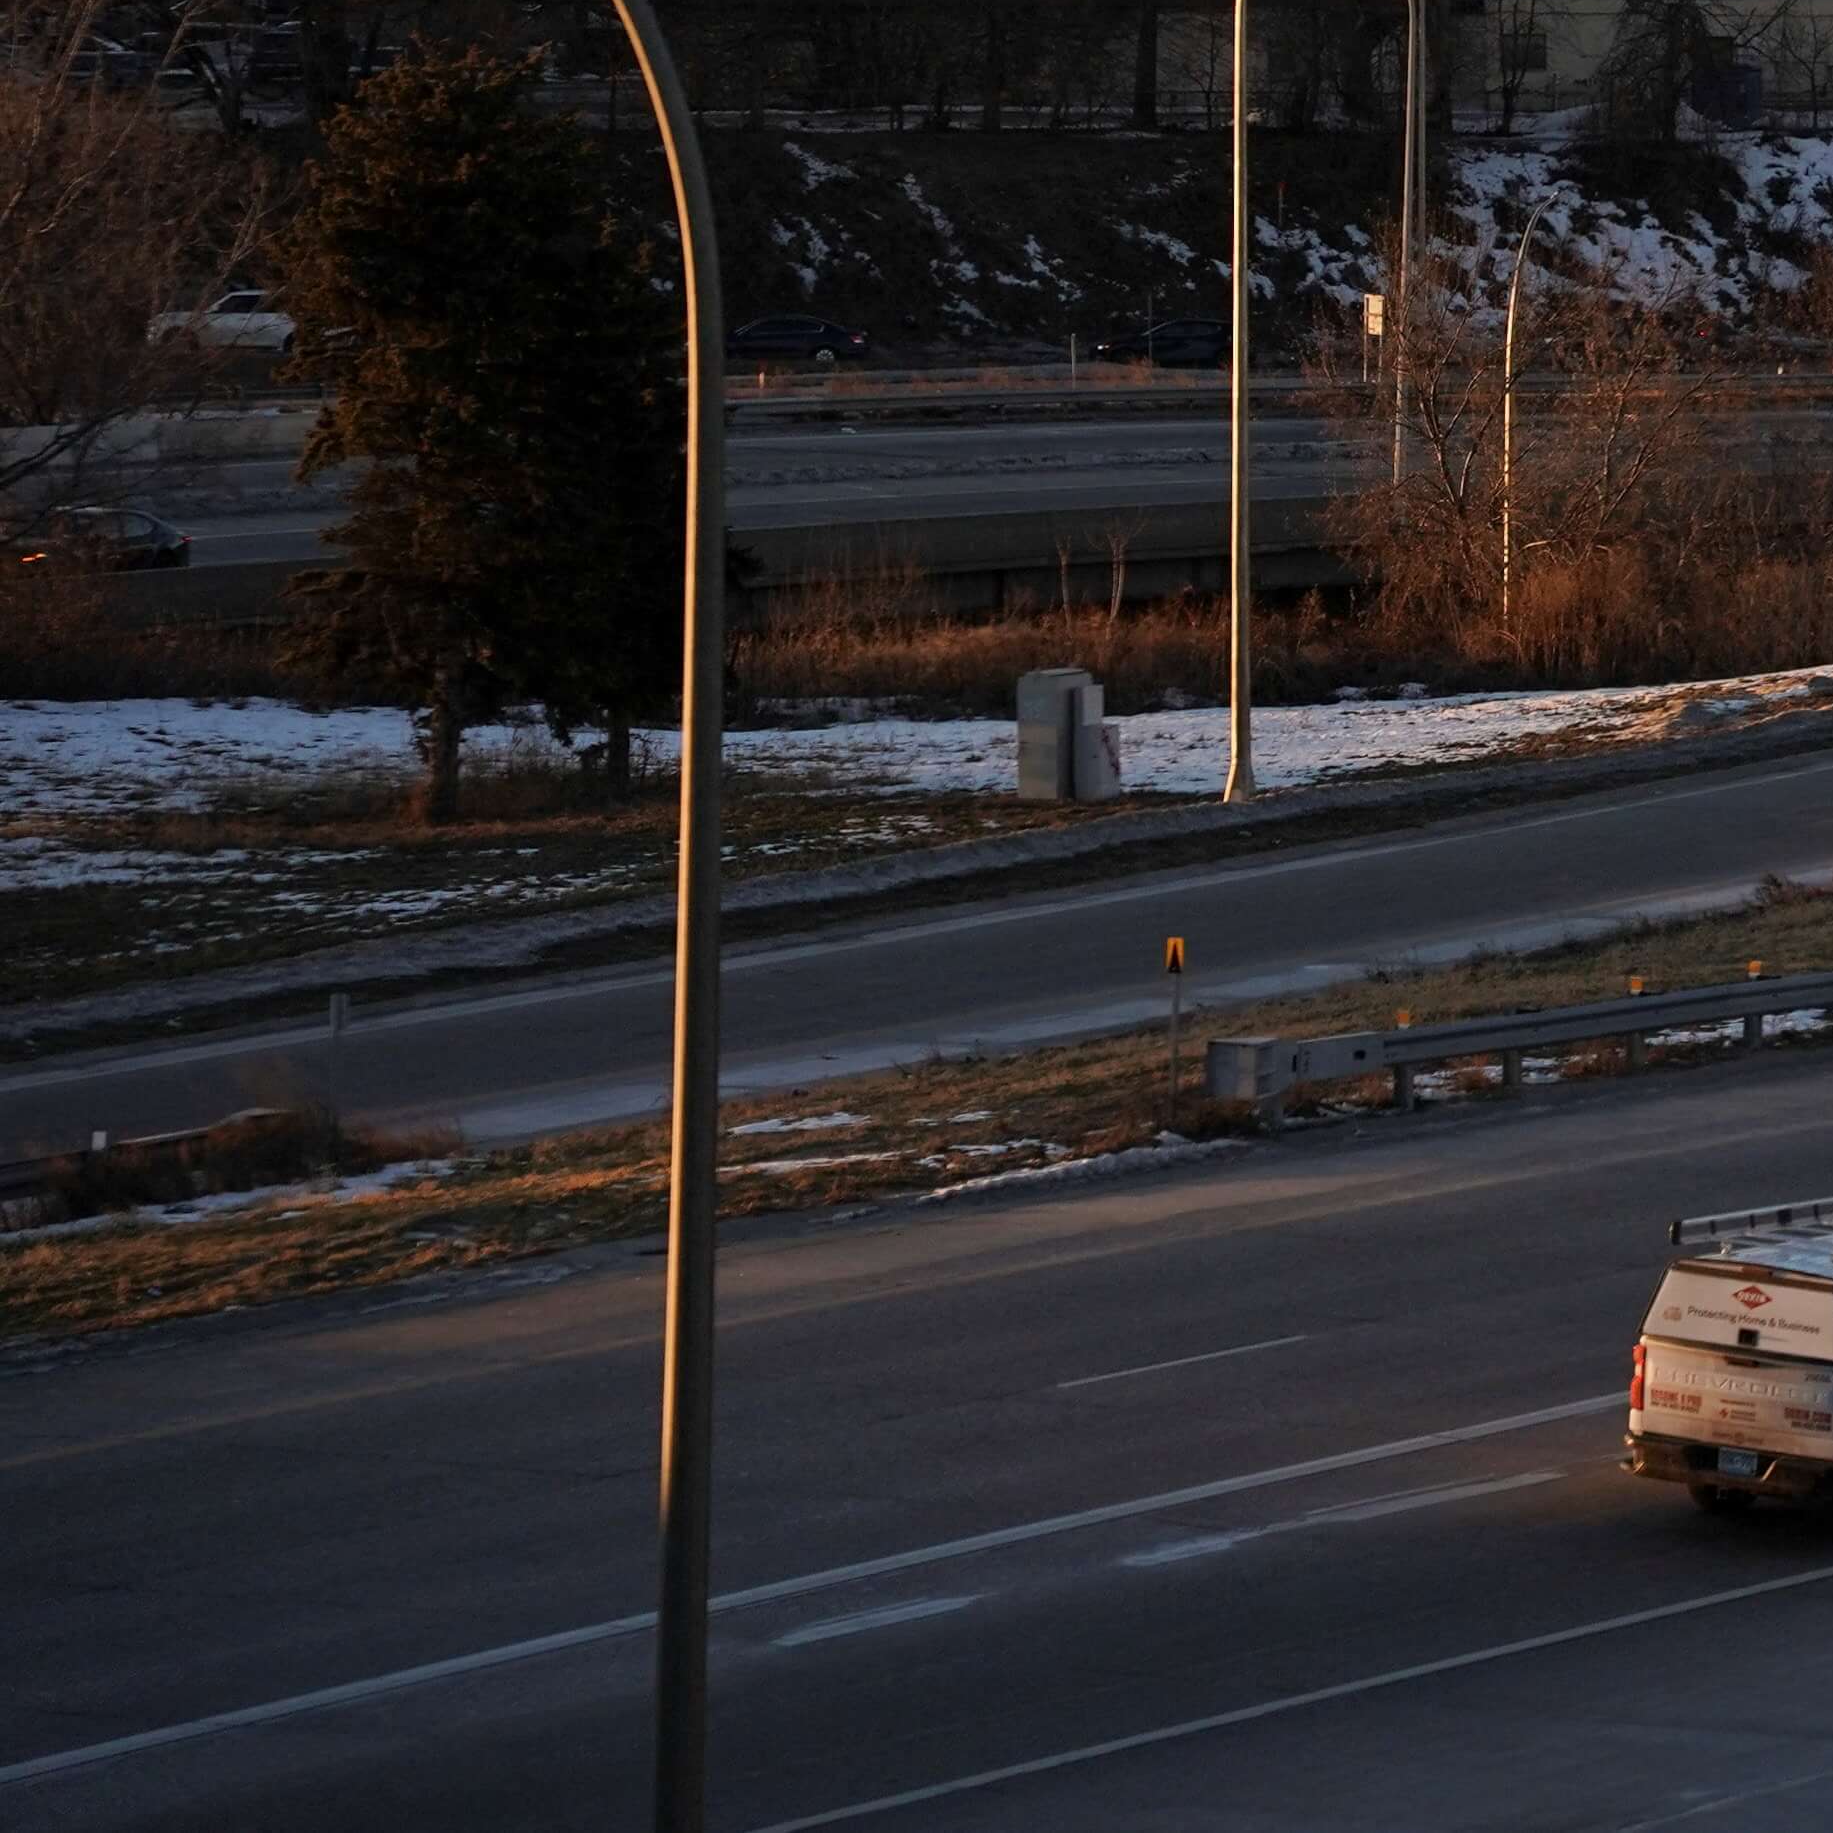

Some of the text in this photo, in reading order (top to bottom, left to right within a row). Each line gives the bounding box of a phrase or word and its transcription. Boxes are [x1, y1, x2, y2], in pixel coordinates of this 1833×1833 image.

[1737, 1290, 1767, 1304] ORKIN
[1687, 1306, 1737, 1325] Protecting
[1739, 1314, 1767, 1327] Home
[1769, 1316, 1776, 1327] &
[1777, 1318, 1821, 1335] Business
